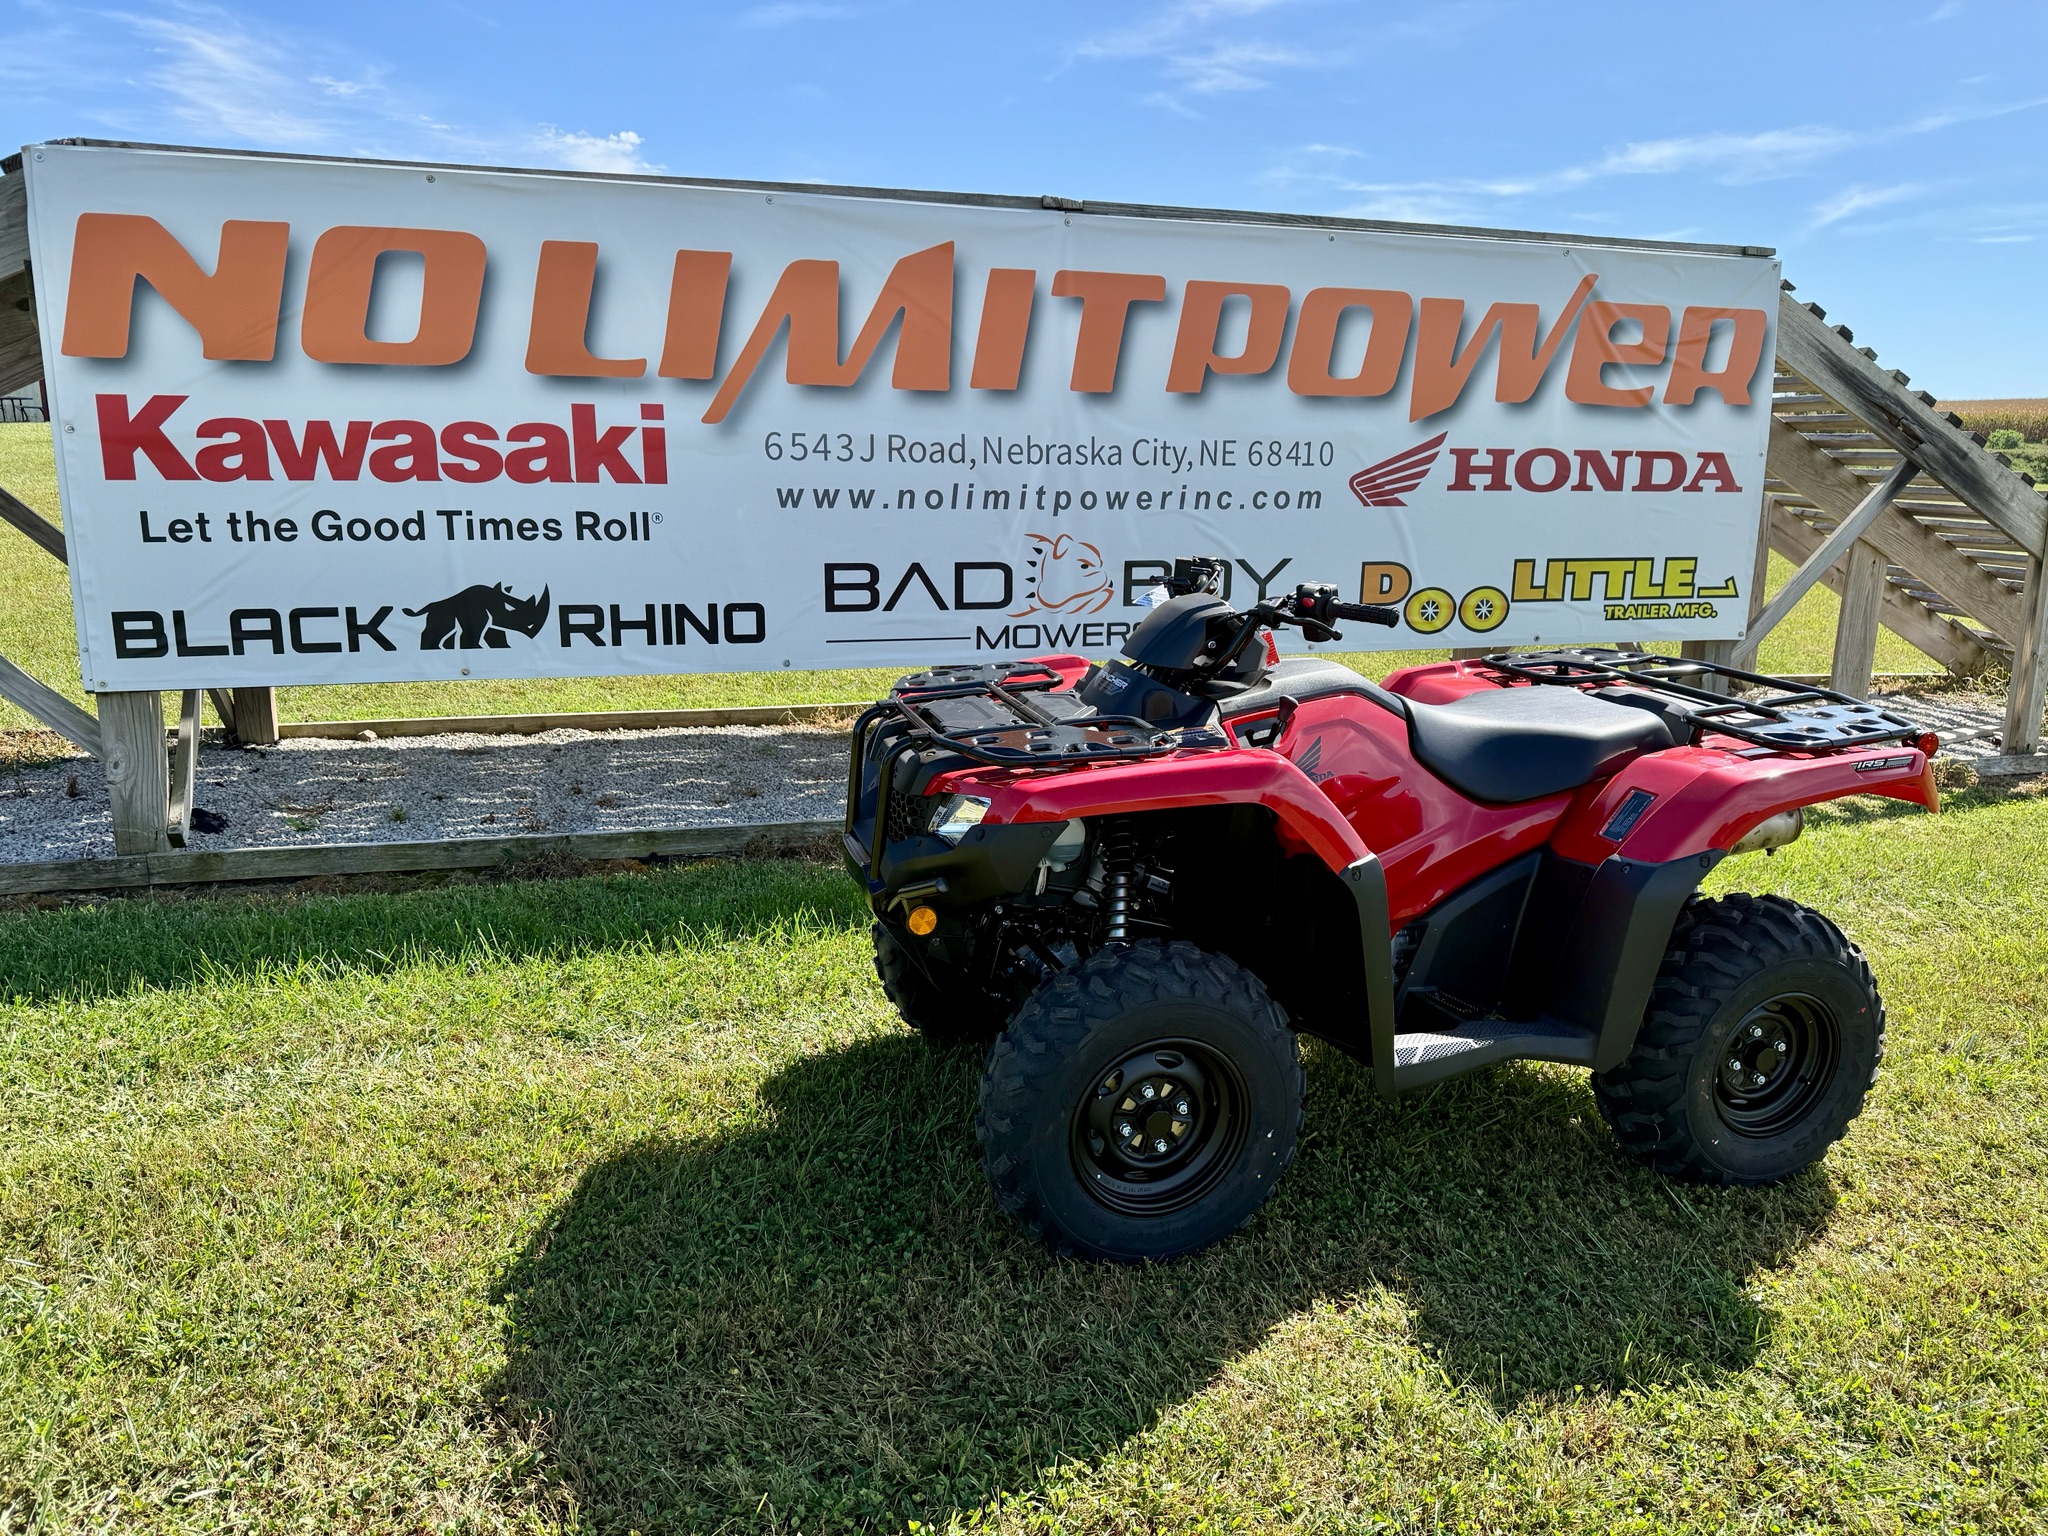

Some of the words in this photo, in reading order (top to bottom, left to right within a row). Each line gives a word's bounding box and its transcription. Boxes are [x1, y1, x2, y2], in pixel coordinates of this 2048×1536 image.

[61, 213, 487, 366] NO
[95, 394, 668, 485] Kawasaki
[982, 435, 1122, 466] Nebraska
[1199, 439, 1237, 467] NE
[1248, 440, 1334, 467] 68410
[1446, 447, 1743, 493] HONDA
[776, 482, 1322, 517] www.nolimitpowerinc.com
[139, 510, 212, 543] Let
[226, 510, 299, 542] the
[311, 509, 426, 542] Good
[436, 509, 563, 542] Times
[823, 560, 1014, 613] BAD
[1604, 604, 1672, 620] TRAILER
[1672, 602, 1718, 619] MFG.
[111, 606, 398, 660] BLACK
[558, 601, 767, 648] RHINO
[976, 621, 1145, 650] MOWER
[1311, 770, 1335, 783] NDA
[1857, 758, 1886, 769] IRS
